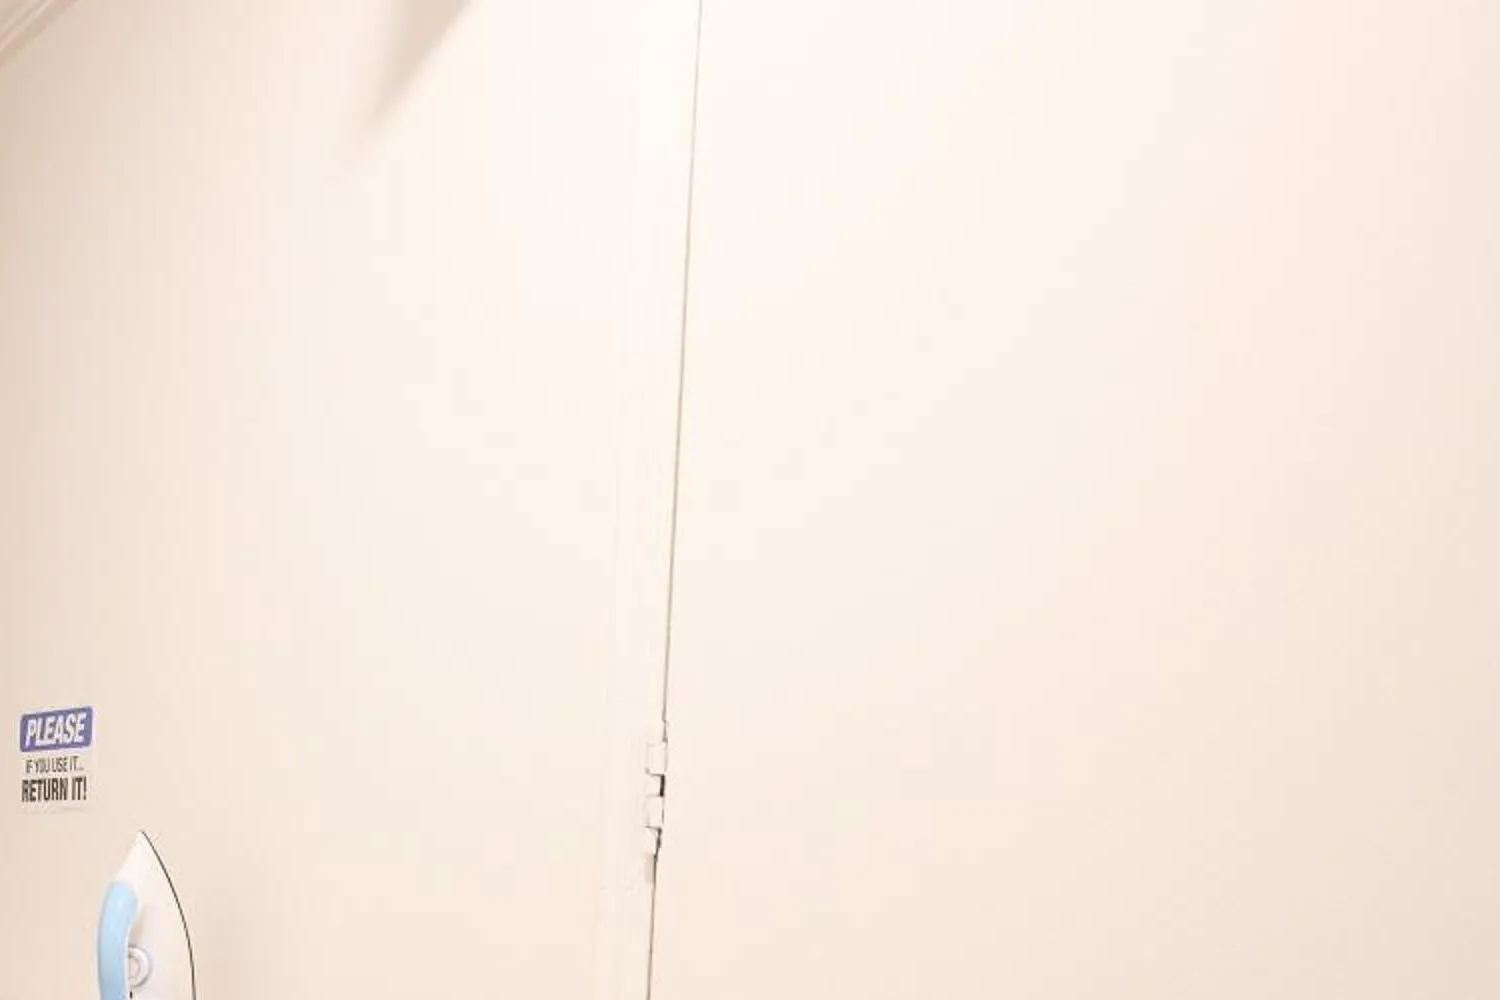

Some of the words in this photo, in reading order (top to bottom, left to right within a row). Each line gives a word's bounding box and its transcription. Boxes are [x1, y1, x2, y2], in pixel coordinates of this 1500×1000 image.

[25, 711, 87, 748] PLEASE
[34, 757, 50, 773] YOU
[52, 756, 68, 772] USE
[21, 778, 68, 802] RETURN
[71, 776, 87, 801] IT!
